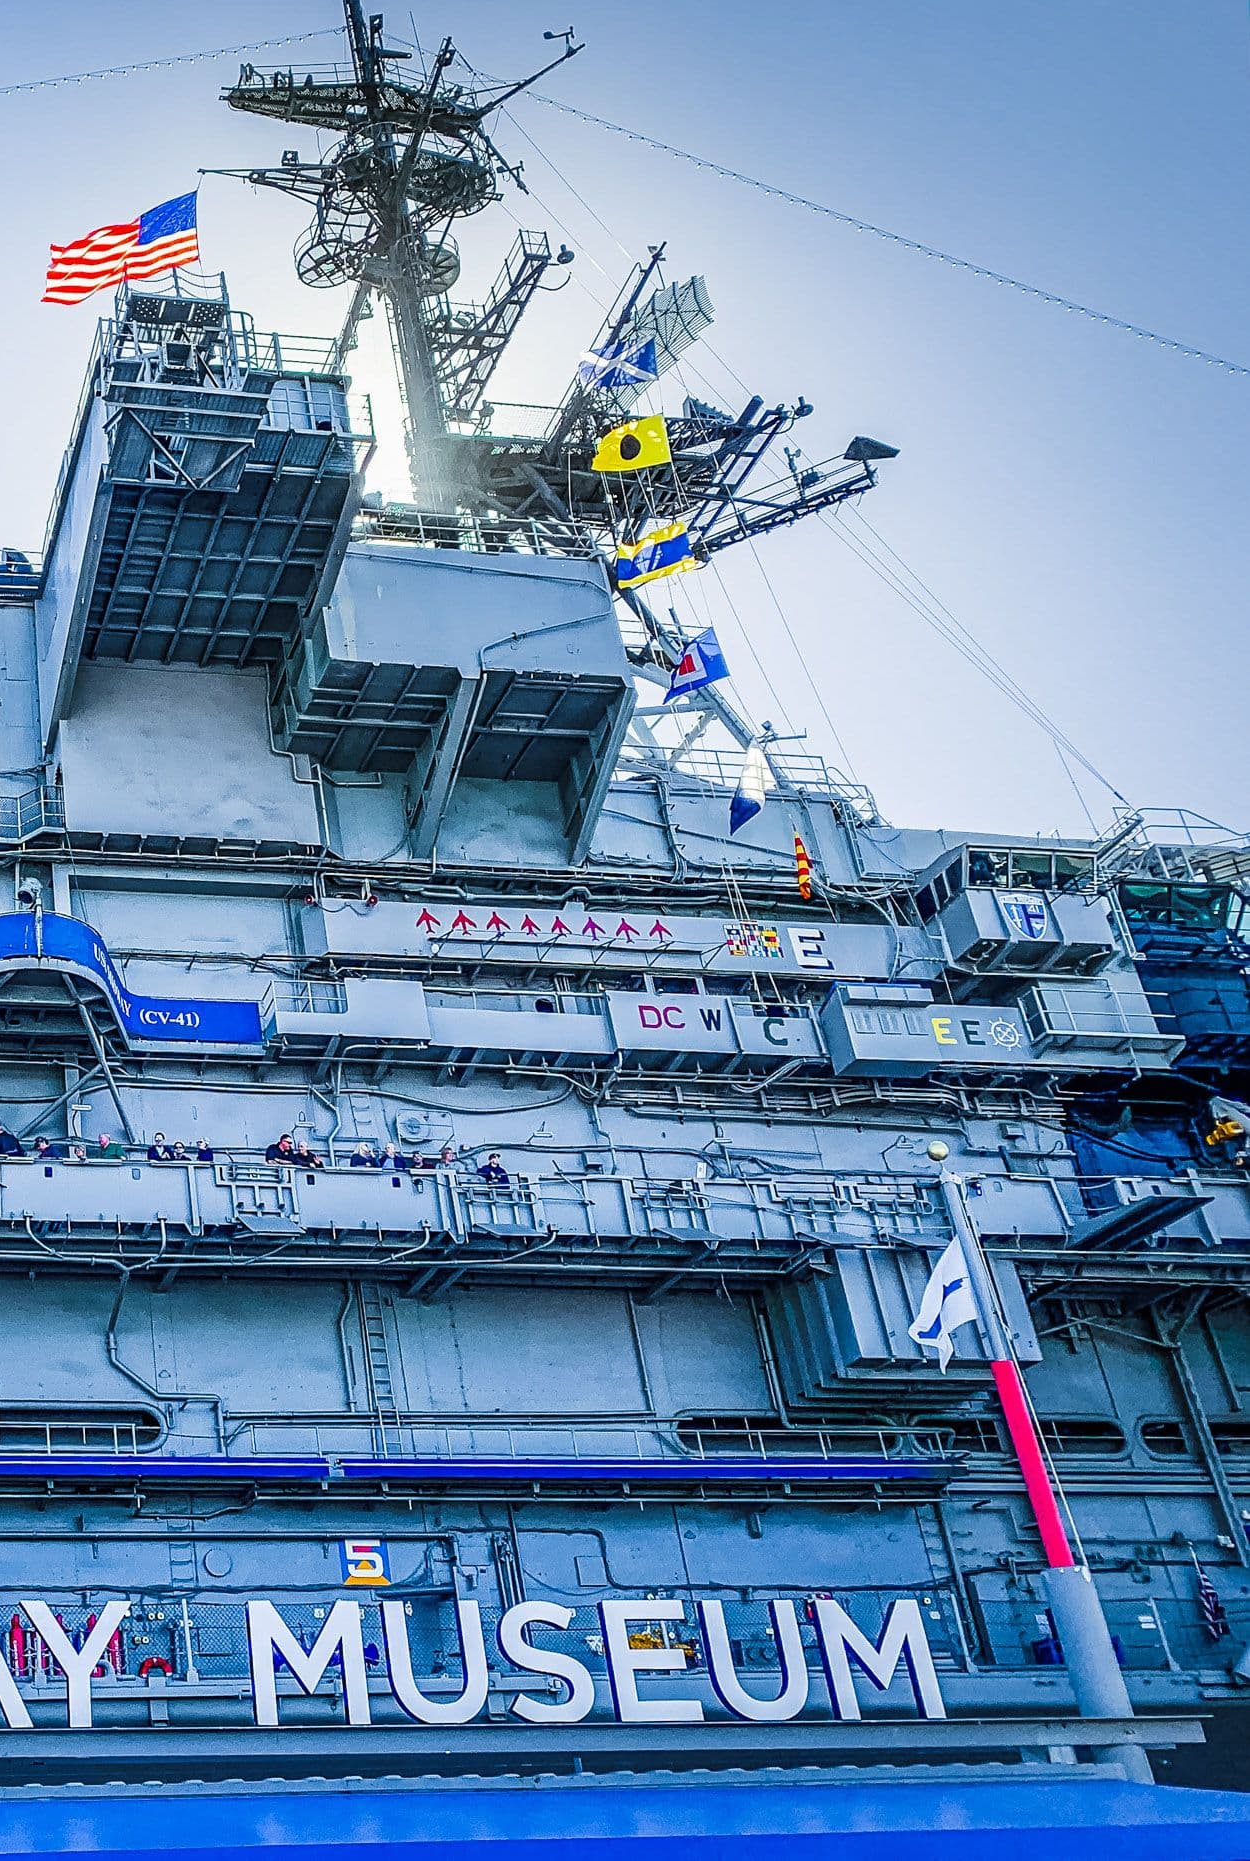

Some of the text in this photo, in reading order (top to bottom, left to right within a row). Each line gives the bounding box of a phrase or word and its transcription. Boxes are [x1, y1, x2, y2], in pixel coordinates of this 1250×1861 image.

[787, 927, 835, 970] E
[106, 964, 131, 1018] MAY
[139, 1008, 200, 1028] (CV-41)
[638, 1004, 721, 1032] DC W
[763, 1017, 788, 1046] C
[931, 1017, 986, 1046] E E
[344, 1539, 384, 1578] 5
[245, 1598, 948, 1727] MUSEUM
